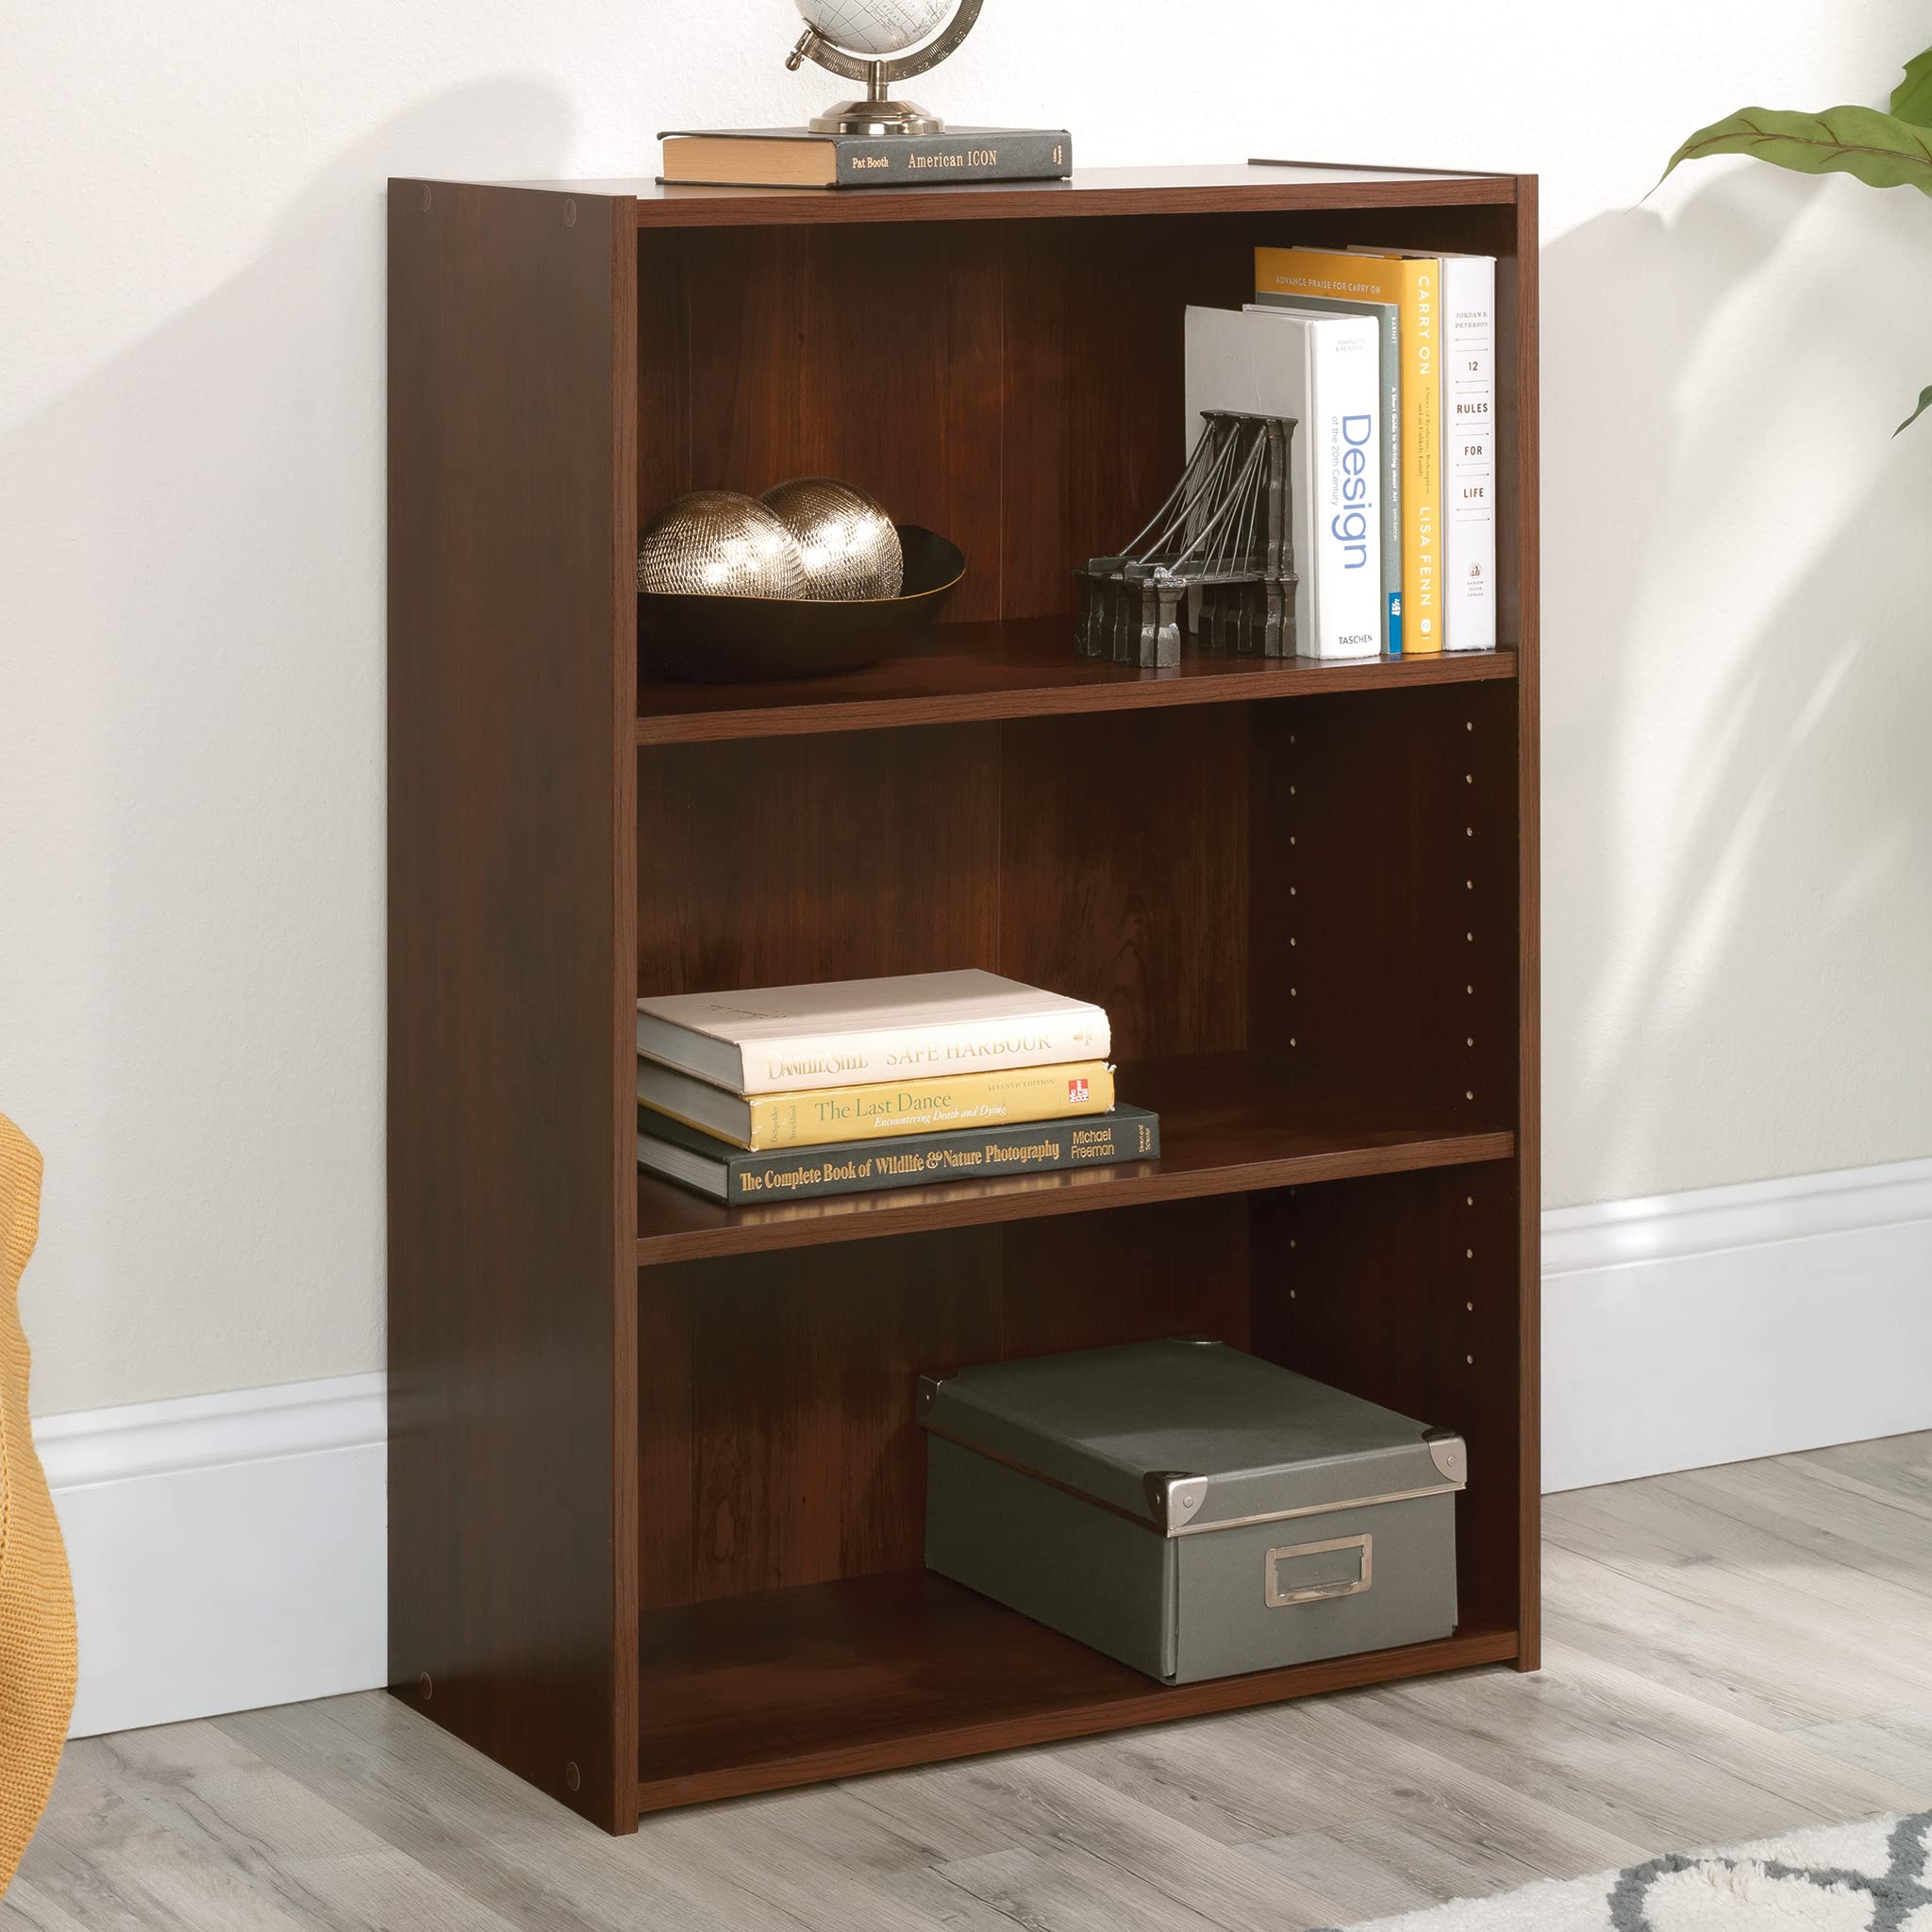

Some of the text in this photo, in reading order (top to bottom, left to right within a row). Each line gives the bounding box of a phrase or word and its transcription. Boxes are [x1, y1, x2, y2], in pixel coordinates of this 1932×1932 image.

[852, 156, 890, 169] Pat Booth
[908, 150, 997, 169] American ICON
[1274, 275, 1381, 294] ADVANCE PRAISE FOR CARRY ON
[1418, 275, 1431, 375] CARRY ON
[1455, 321, 1489, 329] PETERSON
[1468, 360, 1478, 372] 12
[1457, 403, 1489, 414] RULES
[1464, 445, 1483, 456] FOR
[1330, 415, 1341, 507] of the 20th Century
[1331, 414, 1373, 569] Design
[1463, 487, 1484, 498] LIFE
[1420, 507, 1432, 606] LISA FENN
[1339, 634, 1373, 644] TASCHEN
[886, 1041, 940, 1066] SAFE
[945, 1032, 1053, 1060] HARBOUR
[988, 1078, 1056, 1091] SEVENTH EDITION
[1069, 1089, 1076, 1103] Mc
[814, 1092, 952, 1122] The Last Dance
[874, 1104, 1007, 1128] Encountering Death and Dying
[1072, 1127, 1111, 1144] Michael
[1071, 1142, 1115, 1159] Freeman
[740, 1139, 1061, 1191] The Complete Book of Wildlife & Nature Photography
